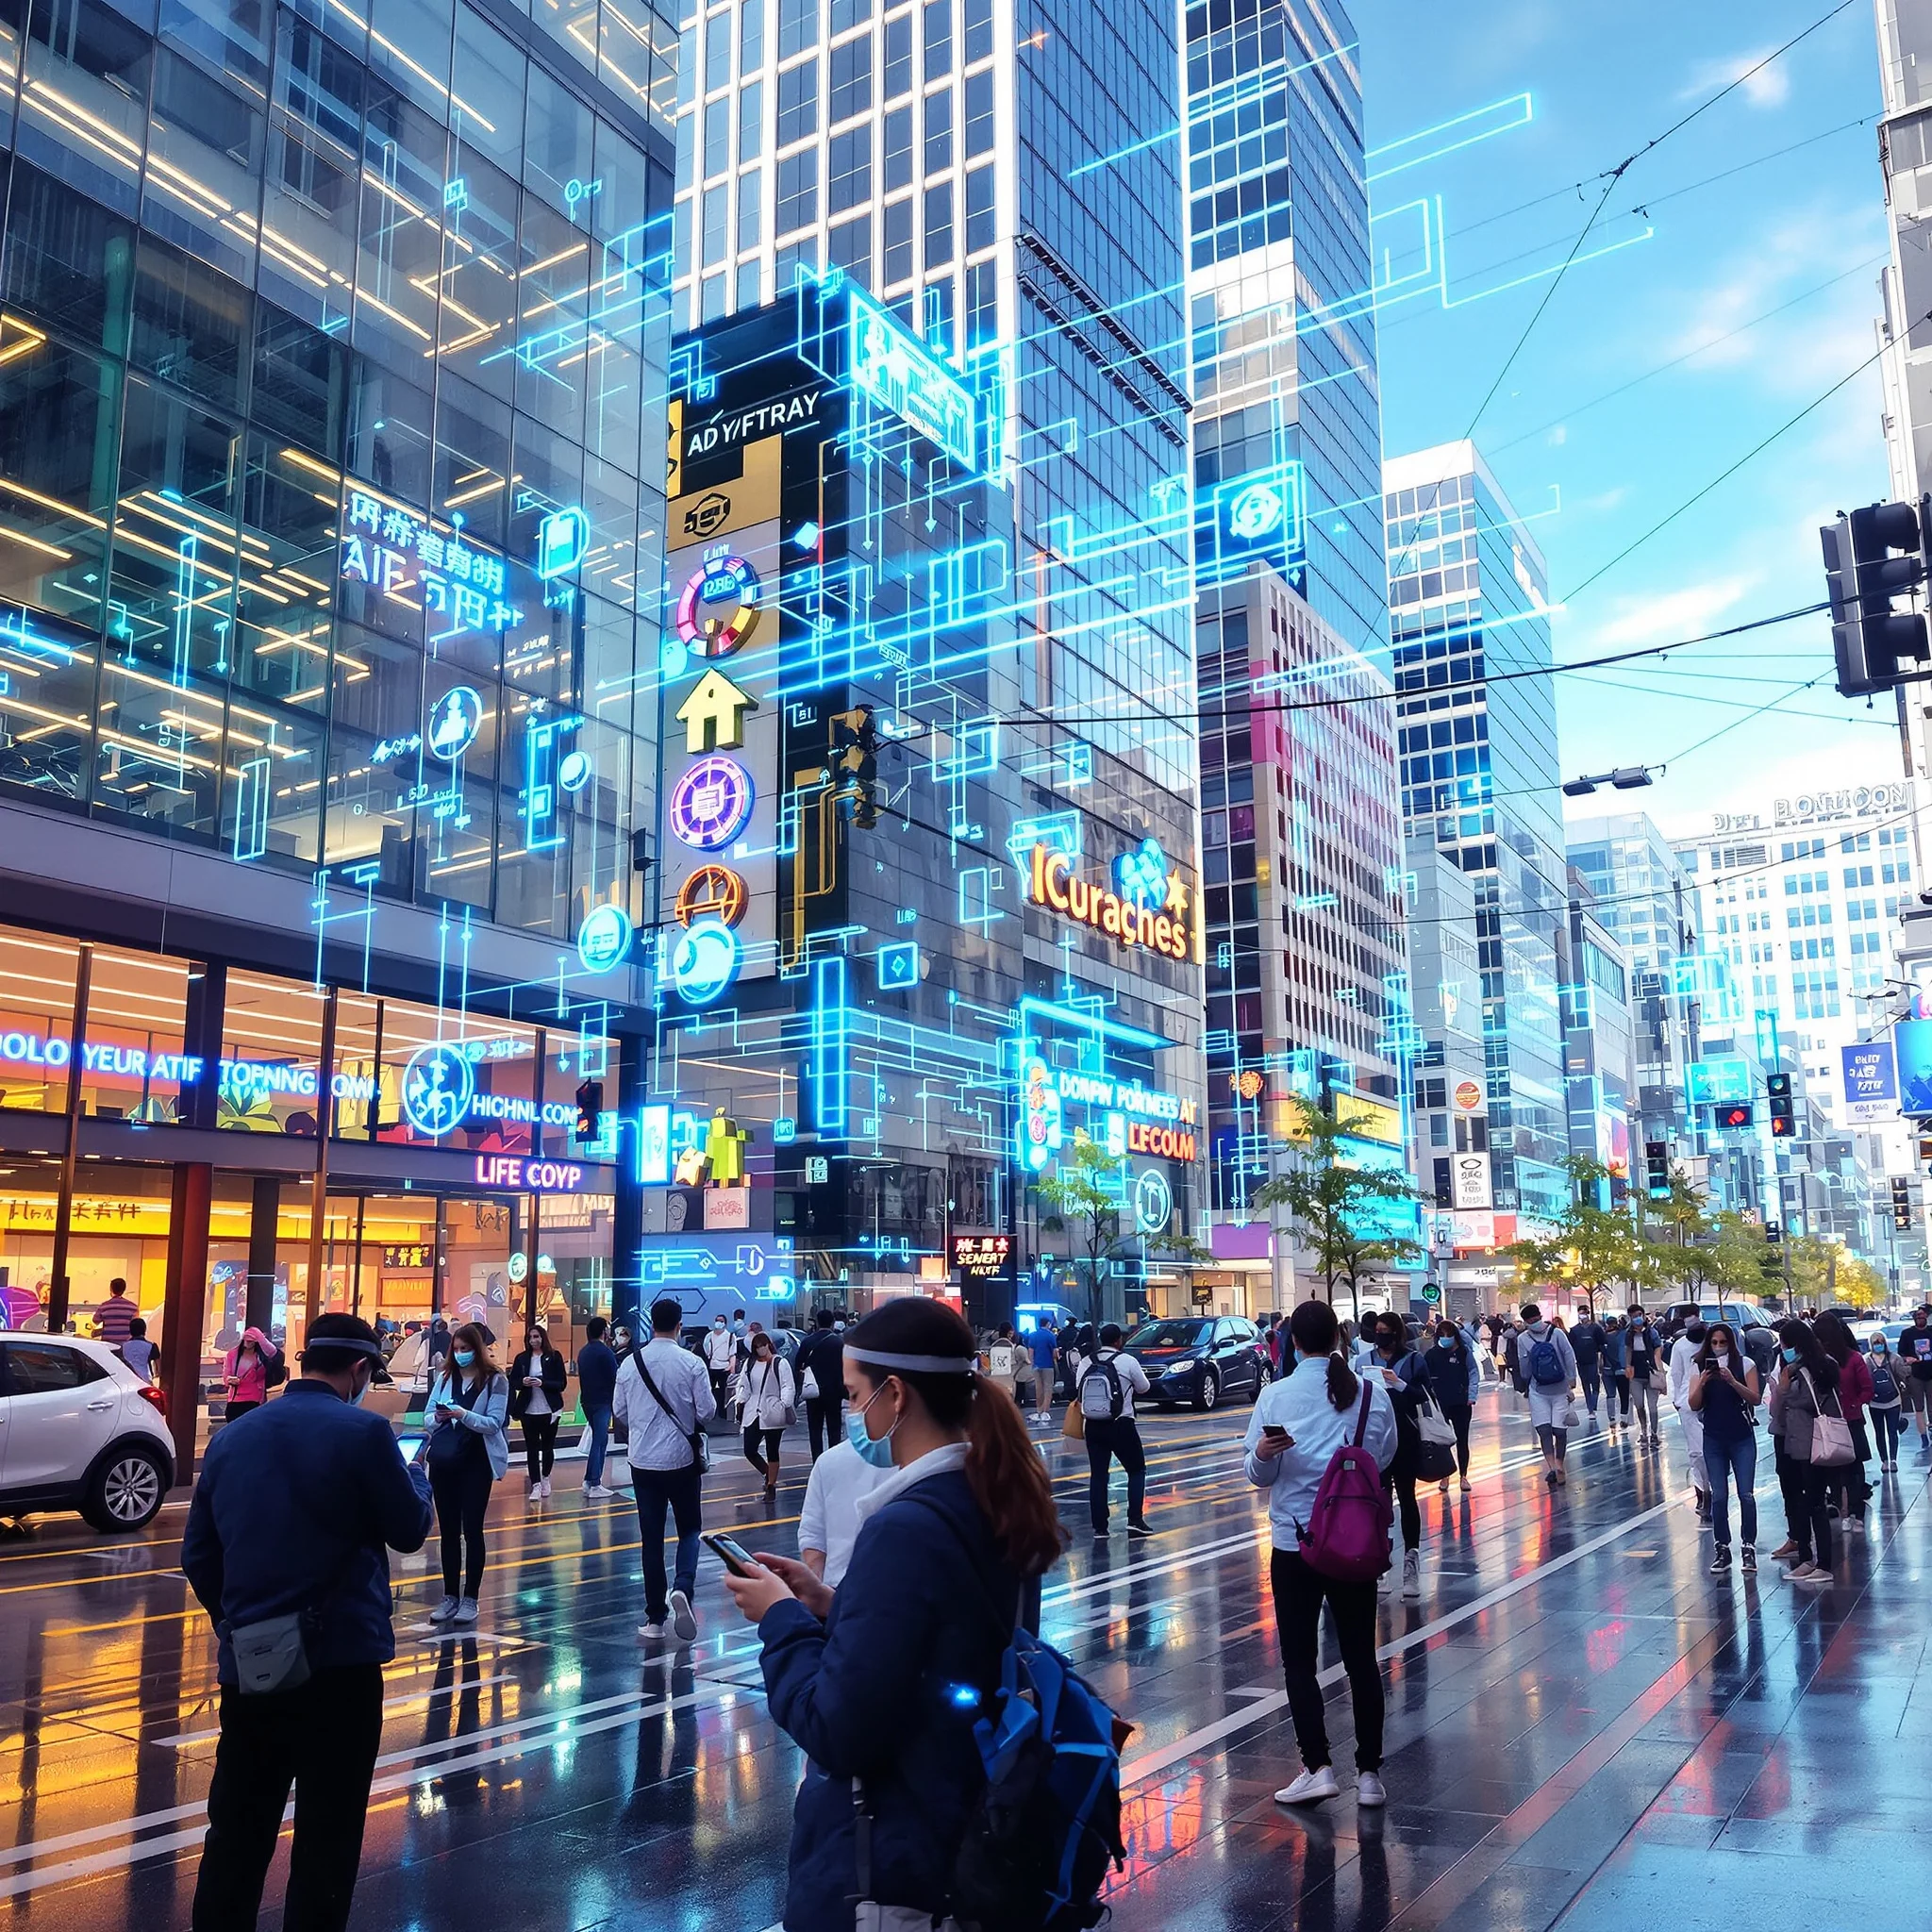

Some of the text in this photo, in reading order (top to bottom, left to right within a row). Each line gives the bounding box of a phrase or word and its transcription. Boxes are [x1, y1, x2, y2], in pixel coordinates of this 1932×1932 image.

[0, 1032, 70, 1066] OLO
[82, 1042, 145, 1076] YEUR
[151, 1054, 204, 1081] ATIF
[476, 1155, 581, 1189] LIFE COYP
